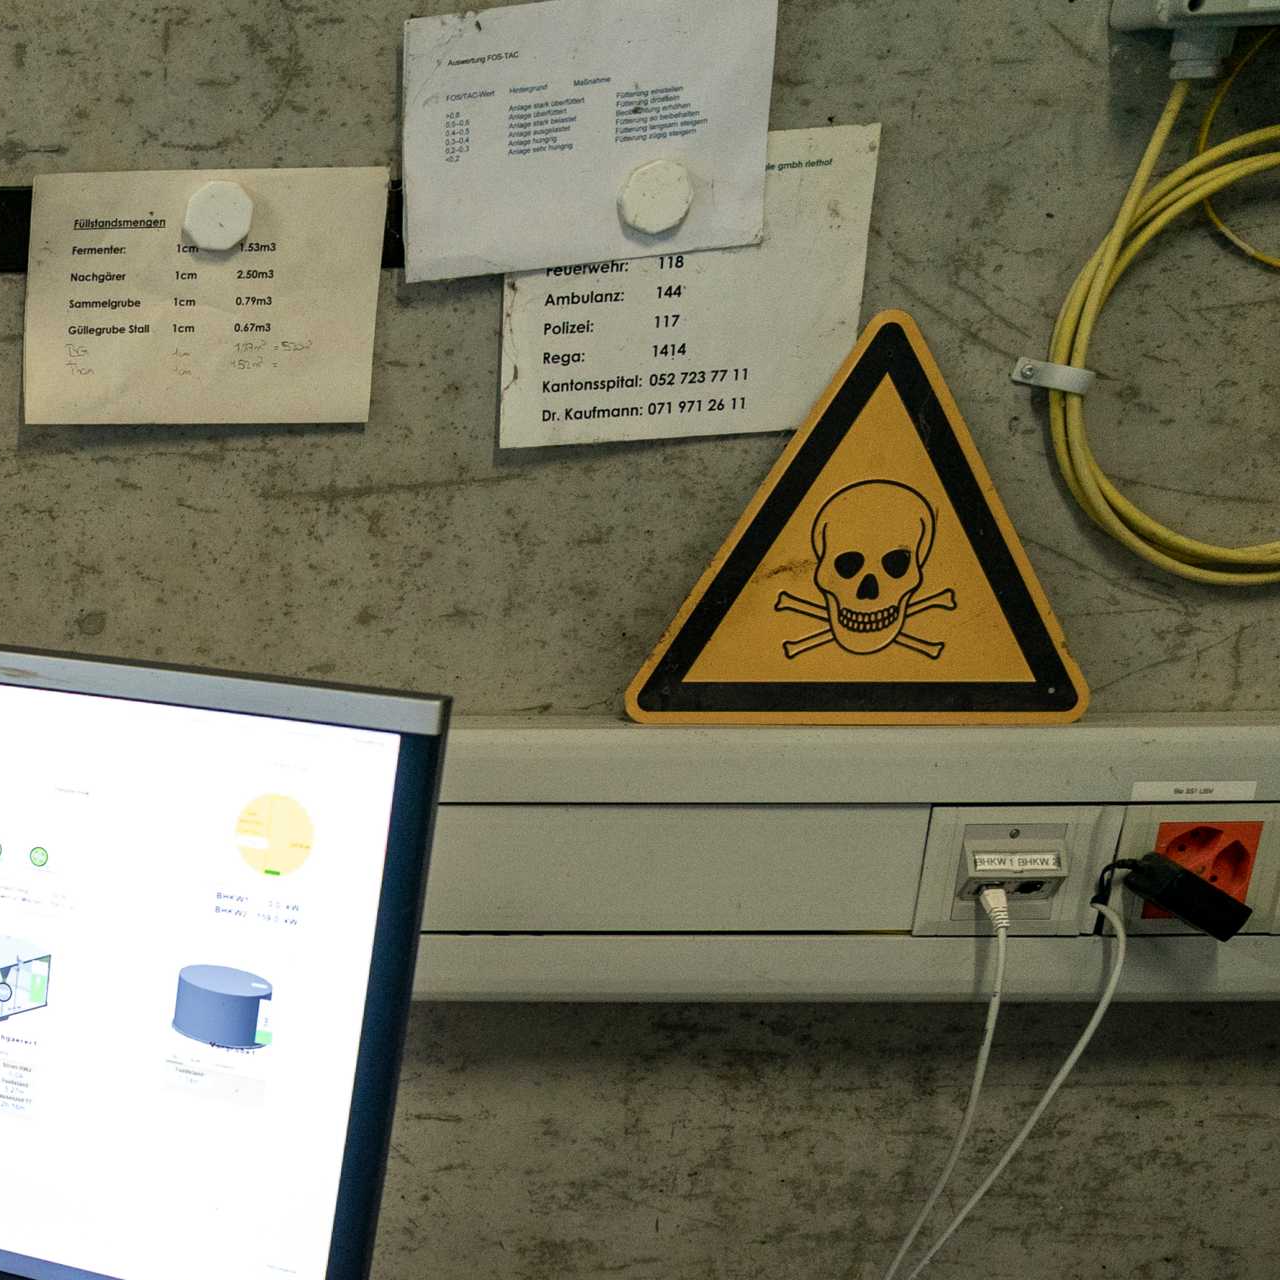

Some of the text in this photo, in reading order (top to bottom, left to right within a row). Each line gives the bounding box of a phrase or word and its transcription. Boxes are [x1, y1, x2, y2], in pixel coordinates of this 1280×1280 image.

[777, 161, 803, 172] gmbh
[71, 245, 127, 256] Fermenter:
[177, 243, 200, 253] 1cm
[659, 255, 685, 270] 118
[70, 269, 275, 284] Nachgärer 1cm 2.50m3
[68, 295, 273, 311] Sammelgrube 1cm 0.79m3
[544, 284, 682, 307] Ambulanz: 144
[67, 322, 271, 337] Güllegrube Stall 1cm 0.67m3
[543, 314, 681, 336] Polizei: 117
[543, 343, 686, 367] Rega: 1414
[542, 367, 748, 393] Kantonsspital: 052 723 77 11
[541, 397, 745, 423] Dr. Kaufmann: 071 971 26 11
[976, 857, 1006, 866] BHKW
[1018, 857, 1049, 867] BHKW
